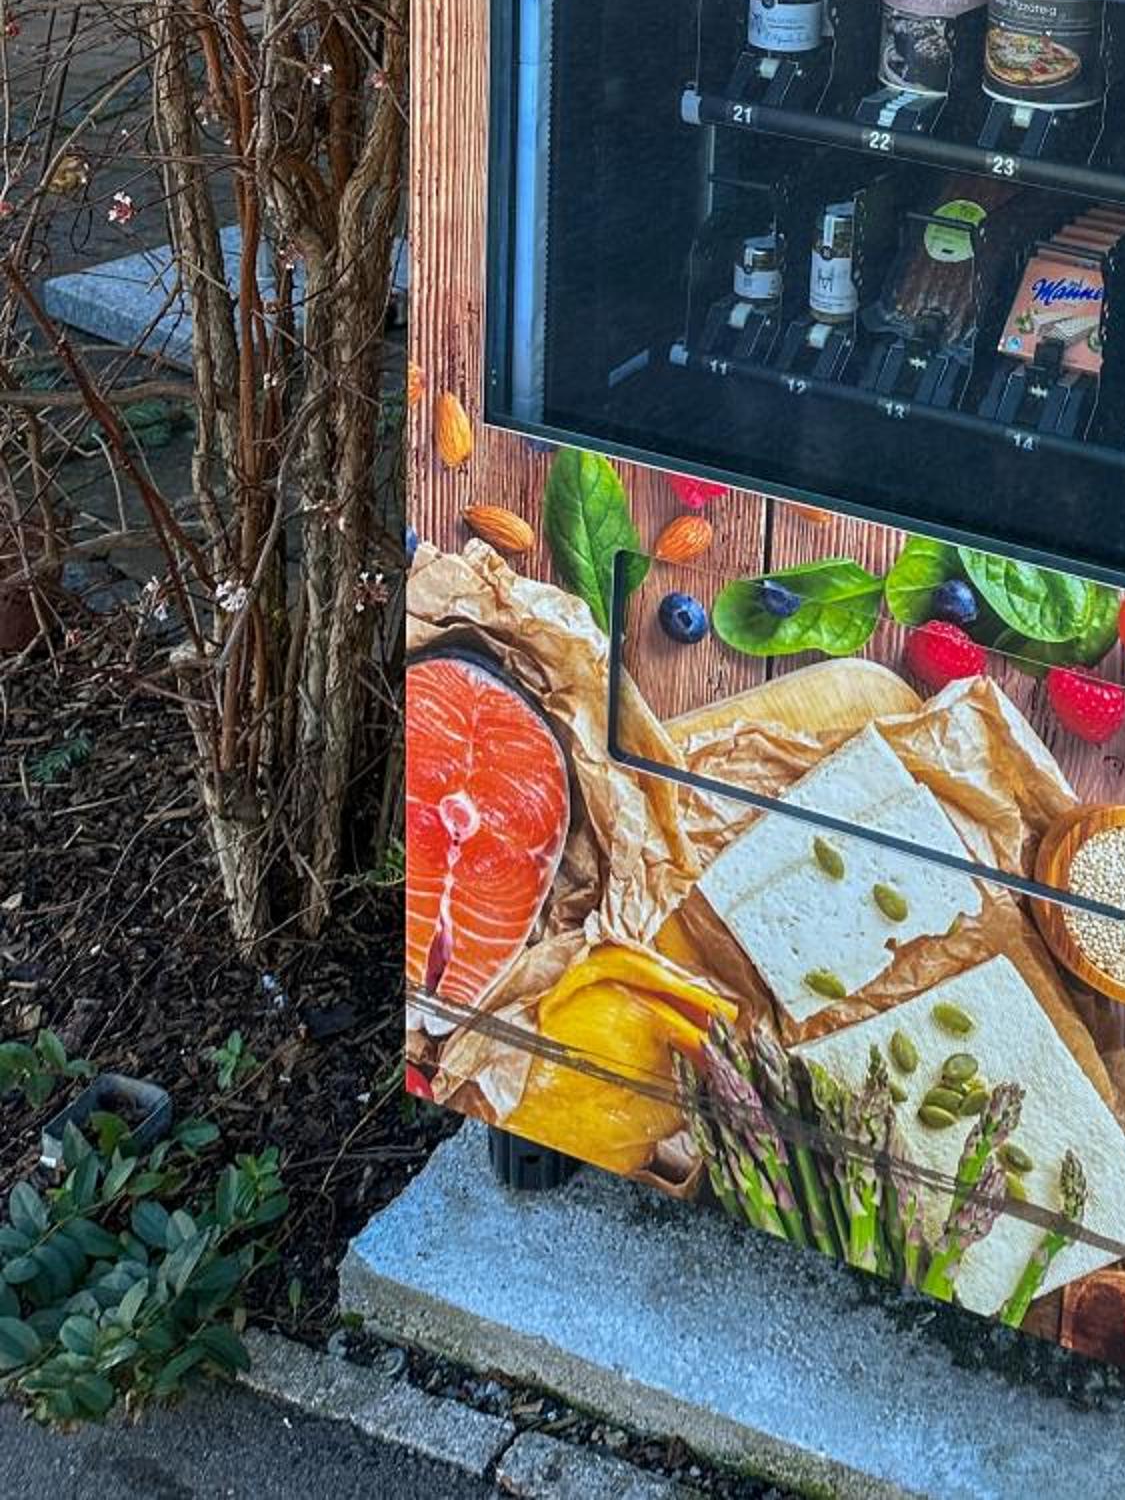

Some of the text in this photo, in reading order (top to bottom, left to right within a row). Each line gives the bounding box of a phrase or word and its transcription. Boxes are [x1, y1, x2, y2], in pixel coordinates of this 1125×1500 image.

[733, 105, 753, 124] 21
[869, 132, 891, 151] 22
[992, 157, 1015, 176] 23
[709, 360, 727, 375] 11
[1013, 433, 1035, 451] 14
